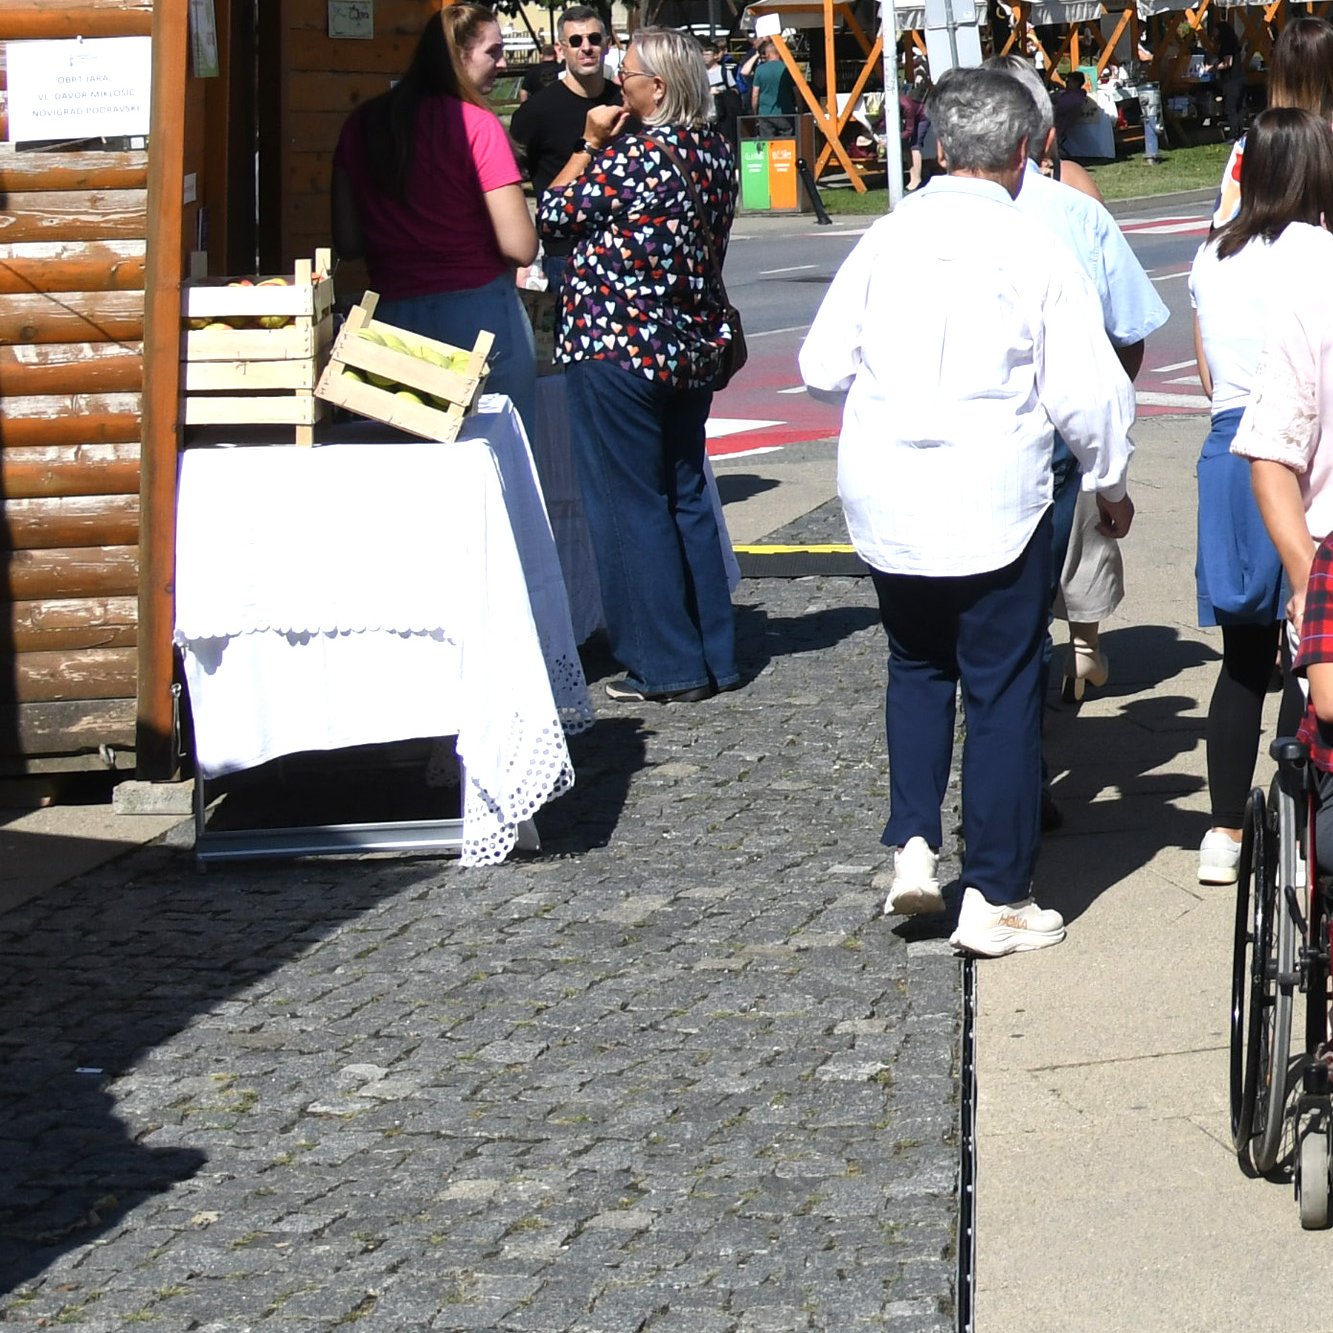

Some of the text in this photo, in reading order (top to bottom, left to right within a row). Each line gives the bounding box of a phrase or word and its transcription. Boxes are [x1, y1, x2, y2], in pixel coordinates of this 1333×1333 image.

[54, 91, 87, 101] DAVOR
[32, 105, 140, 117] NOVIGRAD PODRAVSKI
